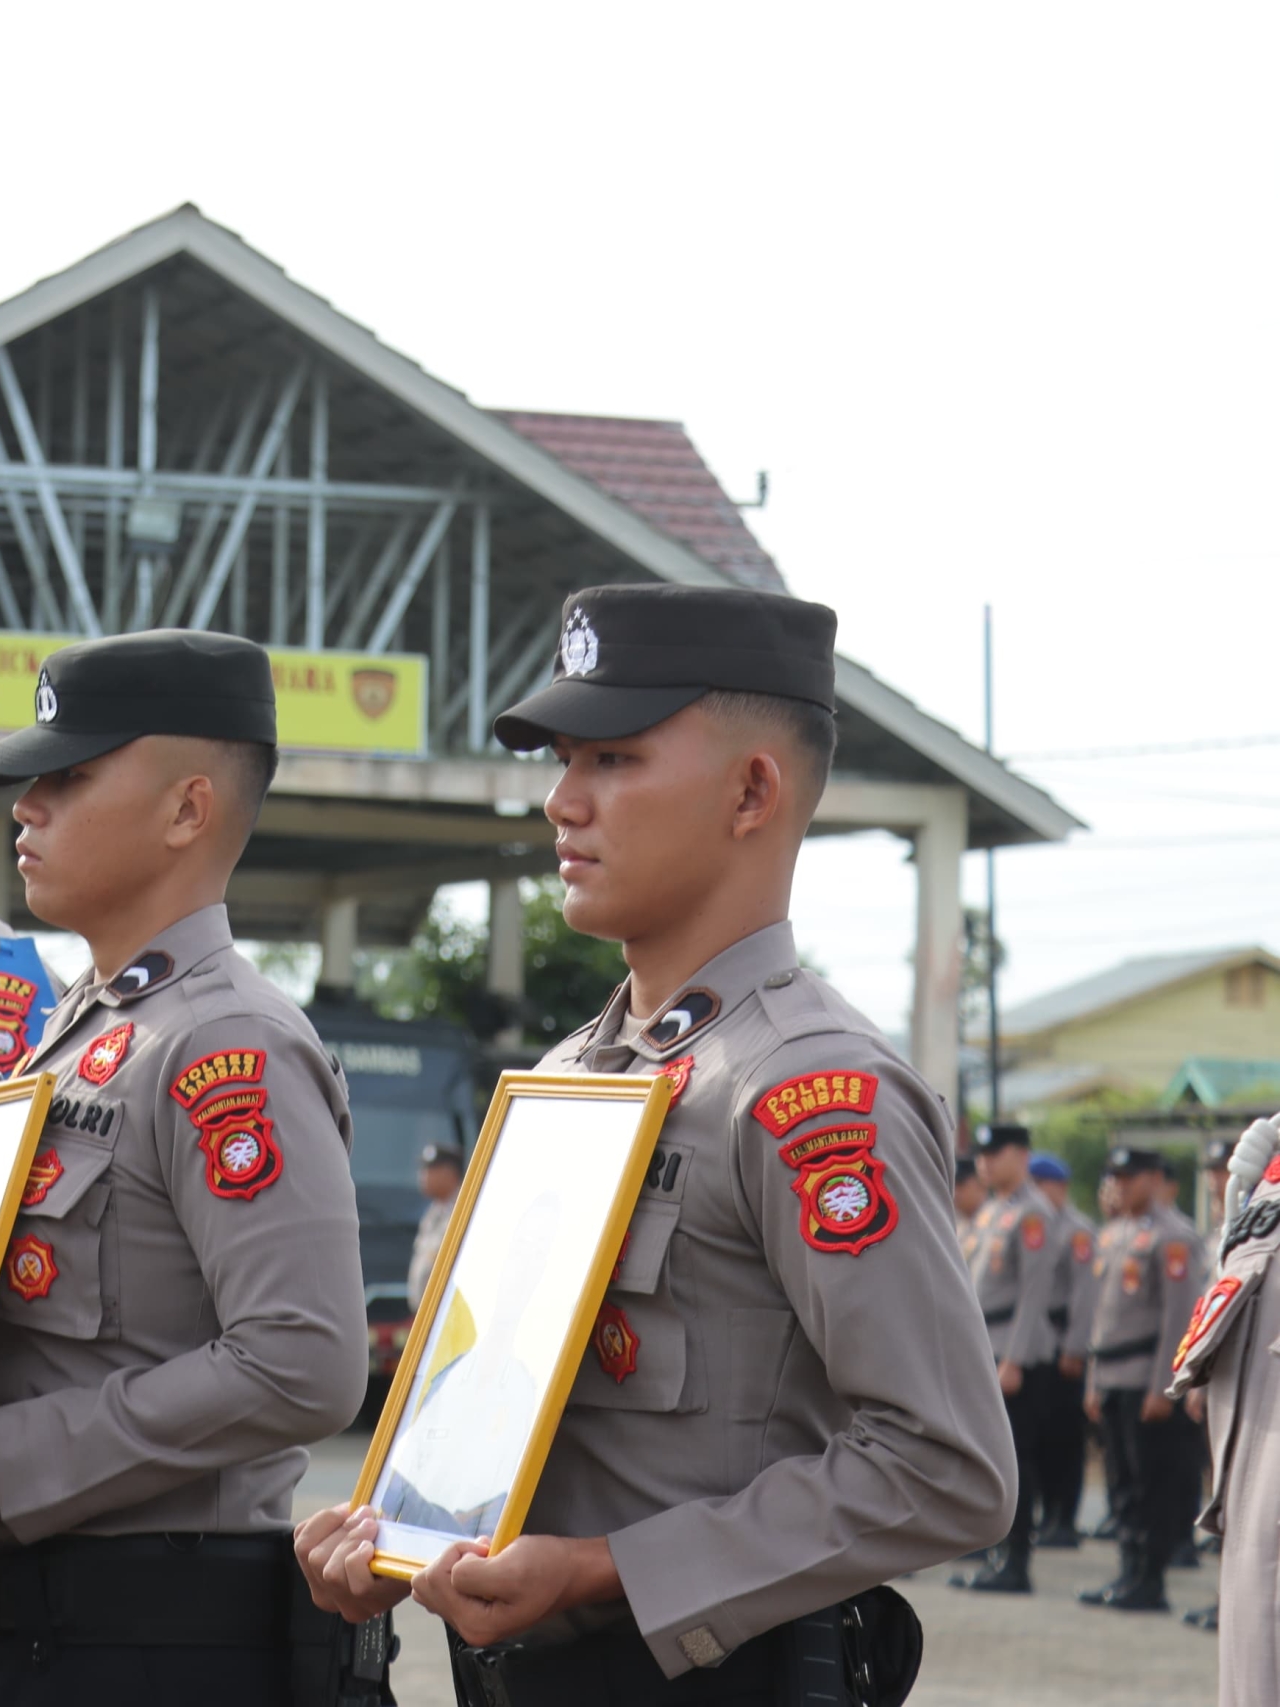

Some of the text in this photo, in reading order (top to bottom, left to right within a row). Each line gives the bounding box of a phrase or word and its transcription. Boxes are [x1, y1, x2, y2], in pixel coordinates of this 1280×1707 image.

[178, 1053, 255, 1091] POLRES
[237, 1094, 260, 1106] BARAT
[767, 1076, 862, 1113] POLRES
[774, 1089, 861, 1125] SAMBAS
[48, 1096, 115, 1137] OLRI
[789, 1130, 869, 1161] KALIMANTAN BARAT
